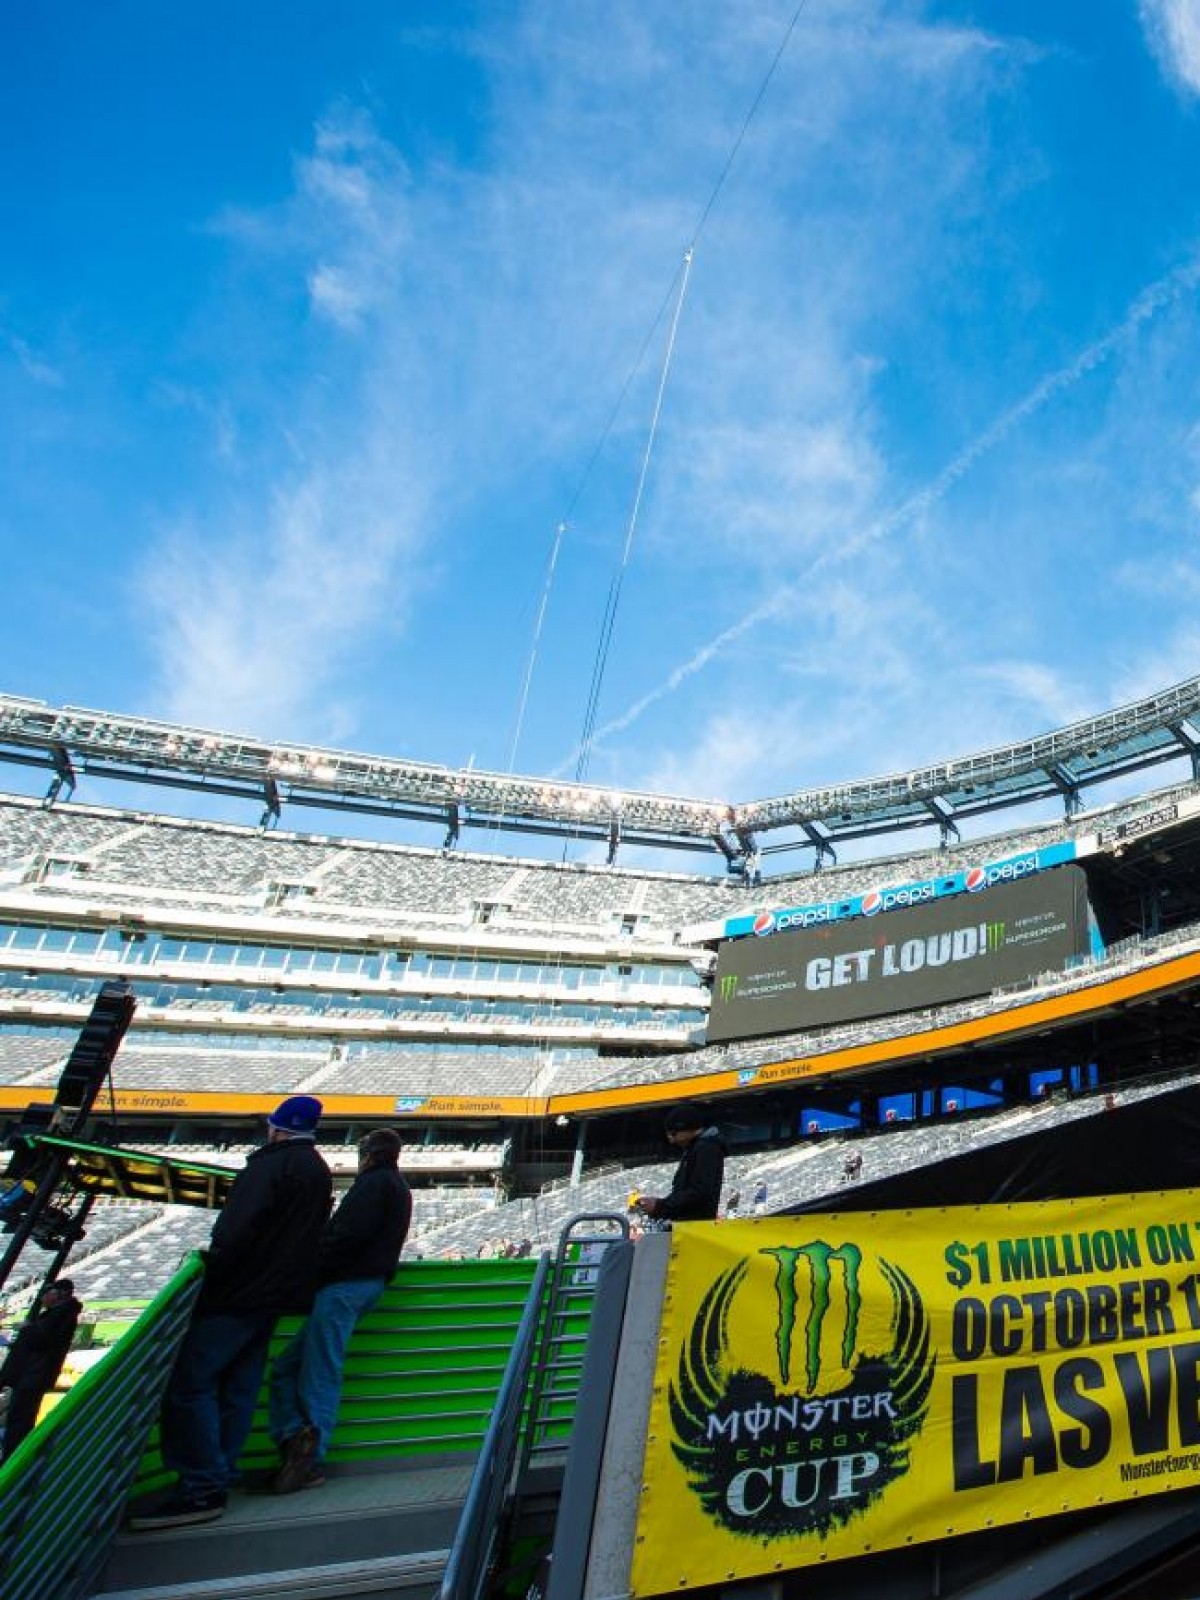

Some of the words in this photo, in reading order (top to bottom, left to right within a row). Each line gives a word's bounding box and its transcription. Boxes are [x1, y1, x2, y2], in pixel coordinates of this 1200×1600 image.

[883, 882, 936, 907] pepsi
[986, 853, 1041, 888] pepsi
[776, 905, 831, 931] pepsi
[804, 948, 876, 992] GET
[881, 922, 987, 977] LOUD!
[428, 1100, 455, 1111] Run
[943, 1240, 990, 1290] $1
[997, 1226, 1142, 1284] MILLION
[1145, 1222, 1194, 1267] ON
[952, 1277, 1175, 1362] OCTOBER
[706, 1391, 898, 1443] MONSTER
[951, 1355, 1113, 1493] LAS
[736, 1431, 868, 1462] ENERGY
[726, 1451, 880, 1517] CUP
